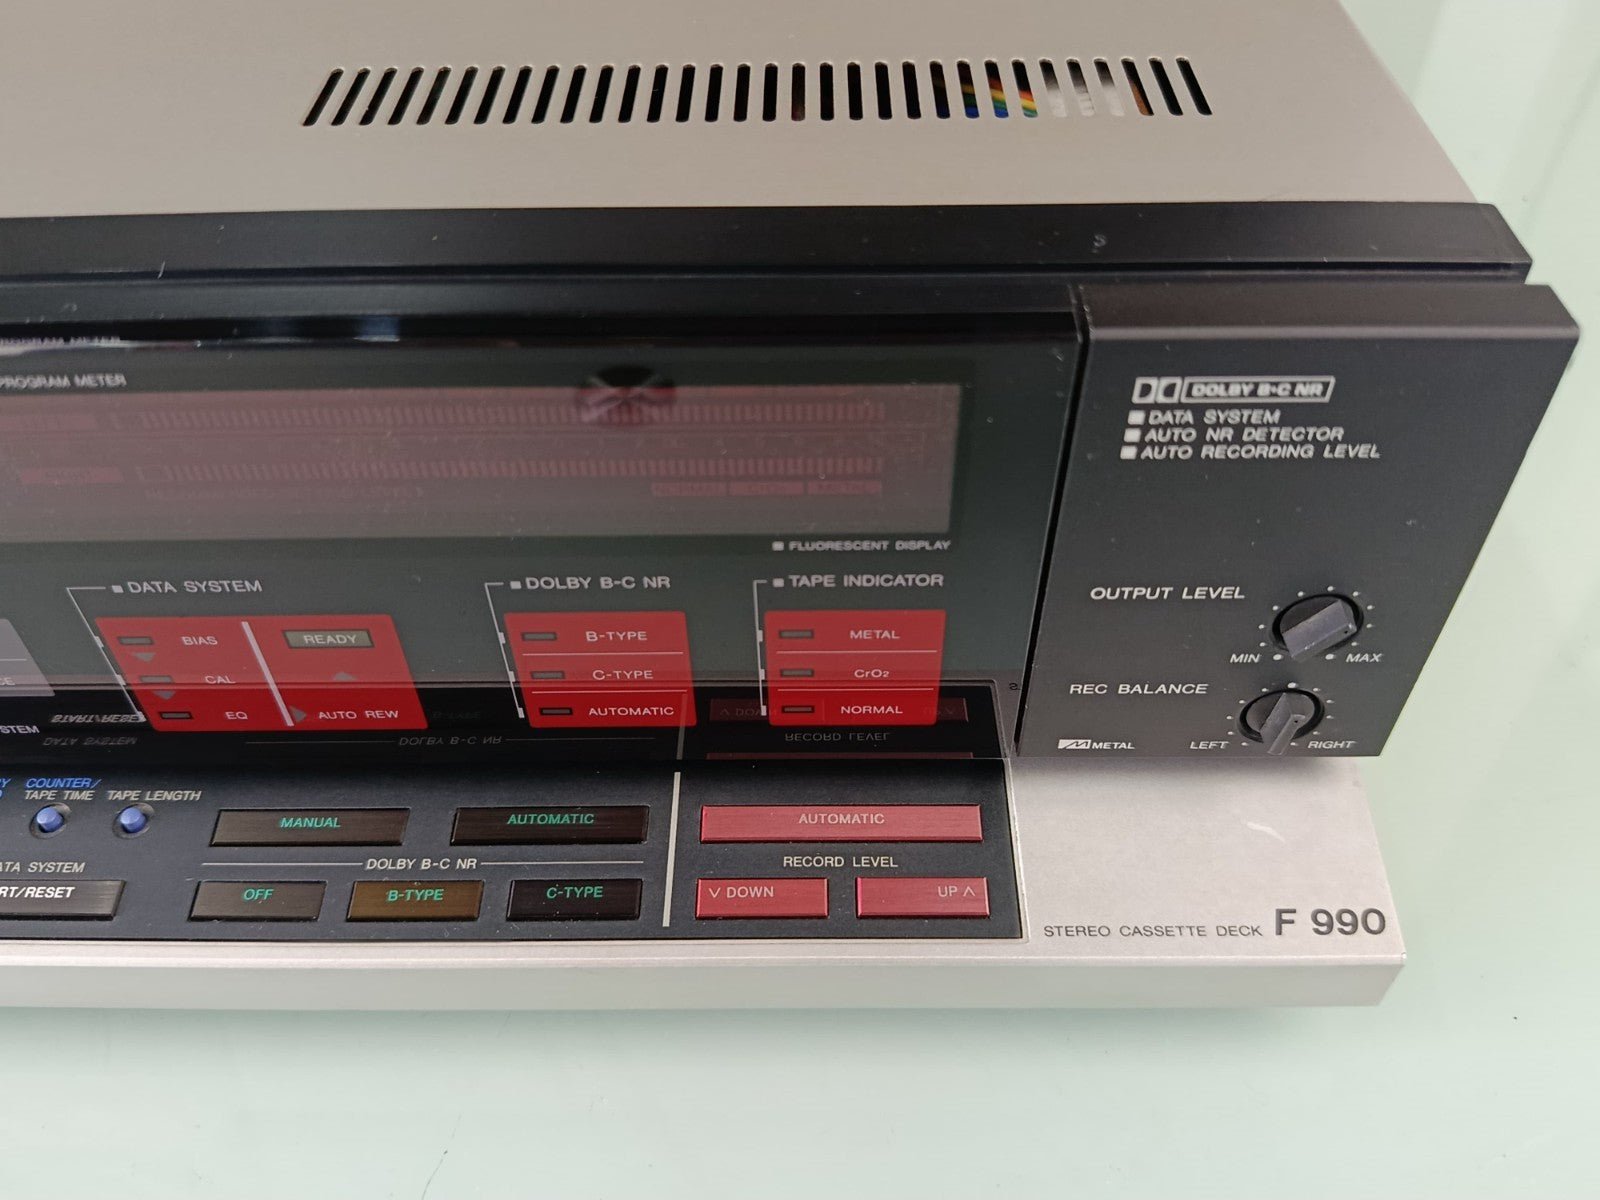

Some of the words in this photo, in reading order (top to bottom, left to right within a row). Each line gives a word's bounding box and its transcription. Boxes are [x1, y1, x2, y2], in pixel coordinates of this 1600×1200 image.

[74, 372, 128, 387] METER
[1191, 384, 1253, 398] DOLBY
[1294, 384, 1324, 397] NR
[1148, 410, 1194, 425] DATA
[1204, 410, 1281, 424] SYSTEM
[1144, 428, 1197, 442] AUTO
[1205, 427, 1233, 442] NR
[1242, 427, 1345, 441] DETECTOR
[1140, 446, 1193, 460] AUTO
[1200, 445, 1315, 459] RECORDING
[1323, 444, 1381, 459] LEVEL
[788, 541, 888, 552] FLUORESCENT
[895, 540, 951, 551] DISPLAY
[526, 577, 592, 590] DOLBY
[600, 577, 636, 590] B-C
[643, 576, 671, 589] NR
[789, 575, 836, 588] TAPE
[844, 574, 945, 587] INDICATOR
[128, 581, 177, 594] DATA
[184, 580, 263, 593] SYSTEM
[1090, 587, 1174, 600] OUTPUT
[1182, 587, 1246, 600] LEVEL
[303, 634, 357, 645] READY
[585, 630, 647, 642] B-TYPE
[850, 629, 900, 640] METAL
[181, 636, 218, 646] BIAS
[1230, 653, 1261, 664] MIN
[1346, 653, 1384, 663] MAX
[205, 675, 236, 684] CAL
[593, 669, 654, 680] C-TYPE
[1069, 683, 1108, 694] REC
[1118, 683, 1209, 695] BALANCE
[318, 710, 357, 720] AUTO
[365, 710, 399, 719] REW
[588, 705, 674, 716] AUTOMATIC
[841, 704, 903, 715] NORMAL
[225, 711, 248, 720] EQ
[0, 725, 40, 734] STEM
[1092, 742, 1135, 750] METAL
[1190, 741, 1230, 750] LEFT
[1308, 741, 1356, 750] RIGHT
[25, 778, 102, 790] COUNTER/
[24, 790, 58, 801] TAPE
[63, 790, 96, 801] TIME
[108, 790, 140, 801] TAPE
[145, 790, 202, 801] LENGTH
[280, 817, 341, 828] MANUAL
[507, 813, 595, 825] AUTOMATIC
[799, 813, 886, 824] AUTOMATIC
[366, 859, 416, 871] DOLBY
[421, 858, 450, 870] B-C
[456, 858, 478, 870] NR
[783, 856, 845, 867] RECORD
[852, 856, 898, 867] LEVEL
[28, 862, 86, 873] SYSTEM
[243, 889, 273, 900] OFF
[386, 889, 444, 901] B-TYPE
[546, 886, 603, 899] C-TYPE
[726, 886, 774, 898] DOWN
[937, 886, 958, 897] UP
[1043, 925, 1111, 937] STEREO
[1119, 925, 1207, 937] CASSETTE
[1216, 925, 1263, 937] DECK
[1274, 908, 1297, 936] F
[1310, 907, 1387, 936] 990
